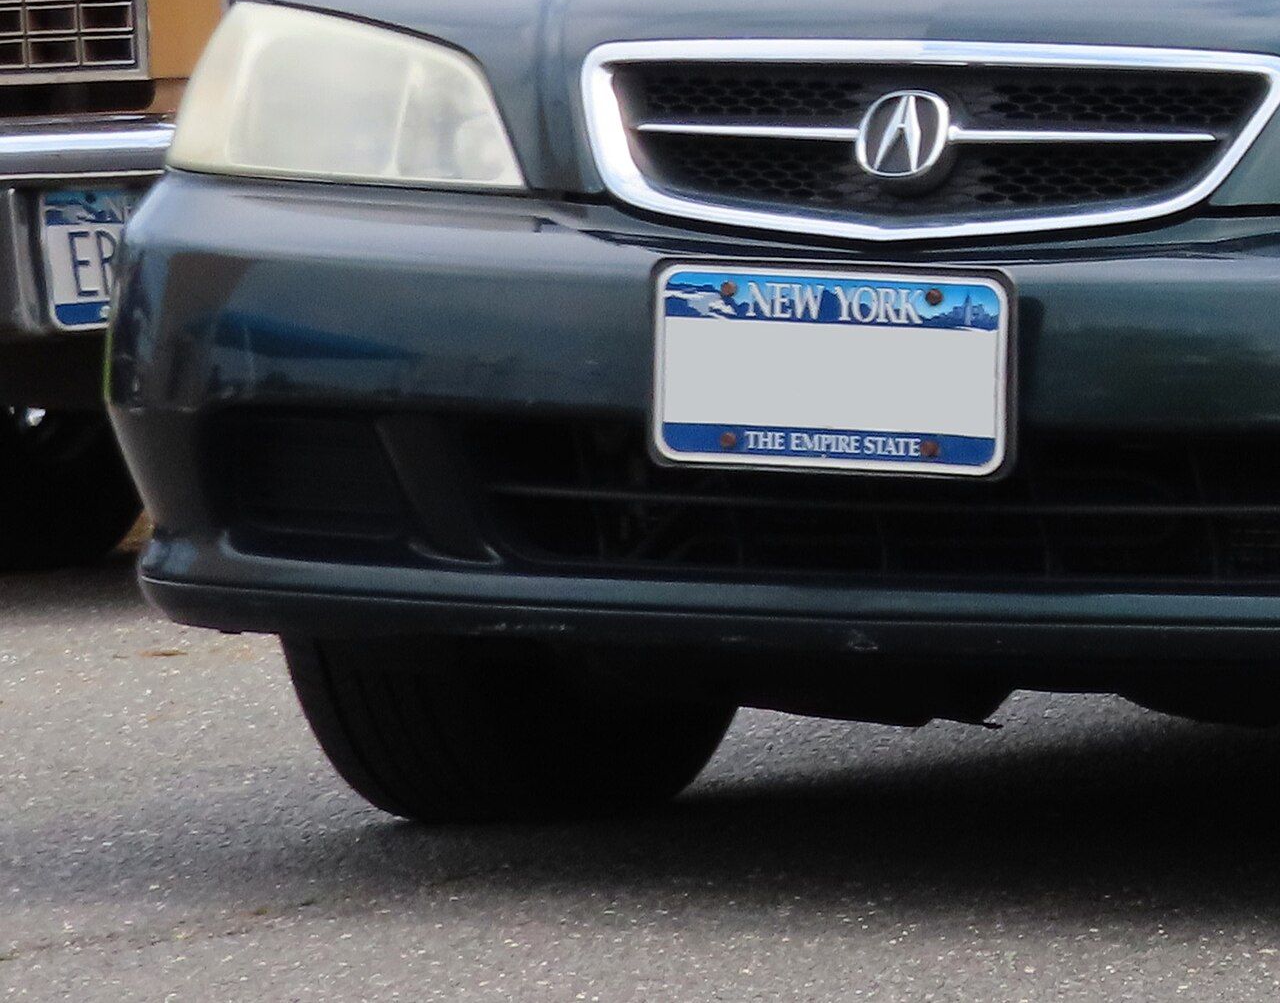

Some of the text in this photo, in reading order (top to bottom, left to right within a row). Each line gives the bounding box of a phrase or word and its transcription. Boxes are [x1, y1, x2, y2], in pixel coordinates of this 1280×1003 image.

[746, 281, 924, 326] NEW YORK
[744, 430, 922, 458] THE EMPIRE STATE
